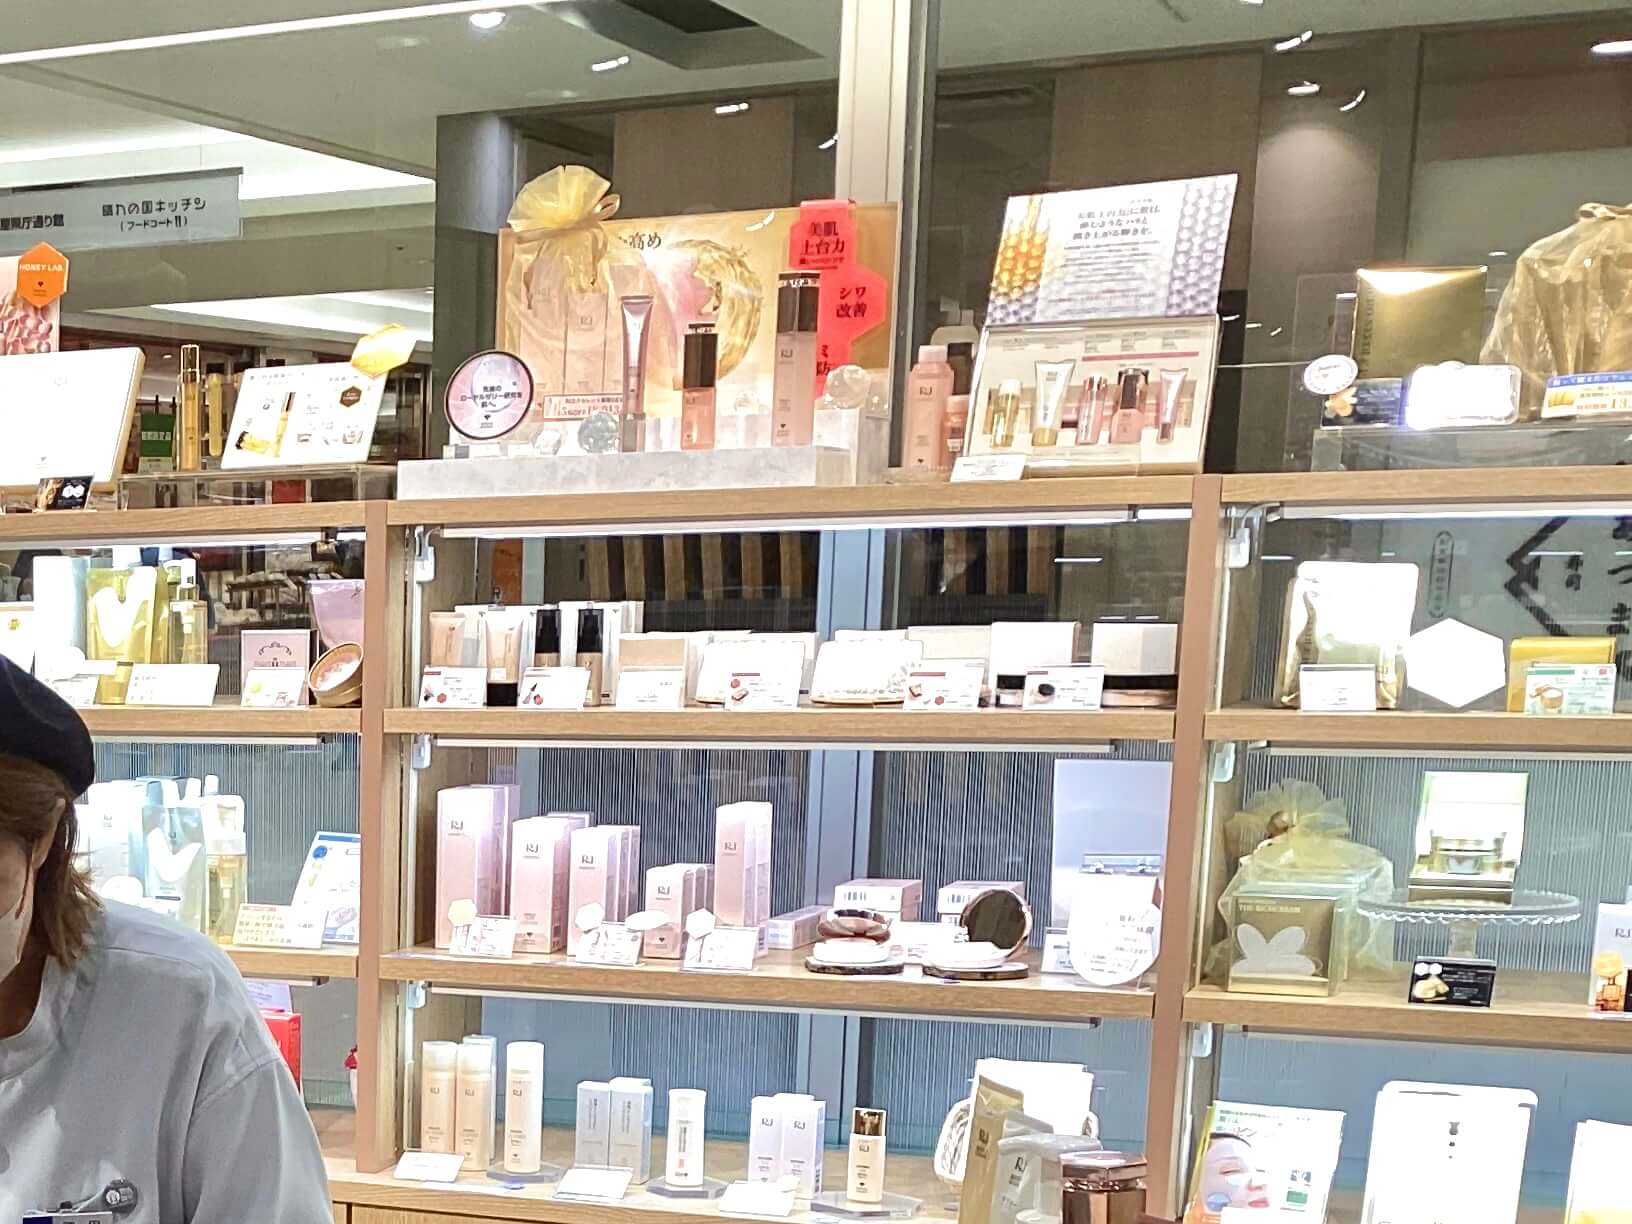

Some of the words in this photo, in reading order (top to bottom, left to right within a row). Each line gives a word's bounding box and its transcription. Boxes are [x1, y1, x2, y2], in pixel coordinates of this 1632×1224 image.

[808, 221, 839, 237] 美肌
[19, 262, 46, 272] HONEY
[839, 286, 867, 299] シワ
[835, 302, 868, 318] 改善
